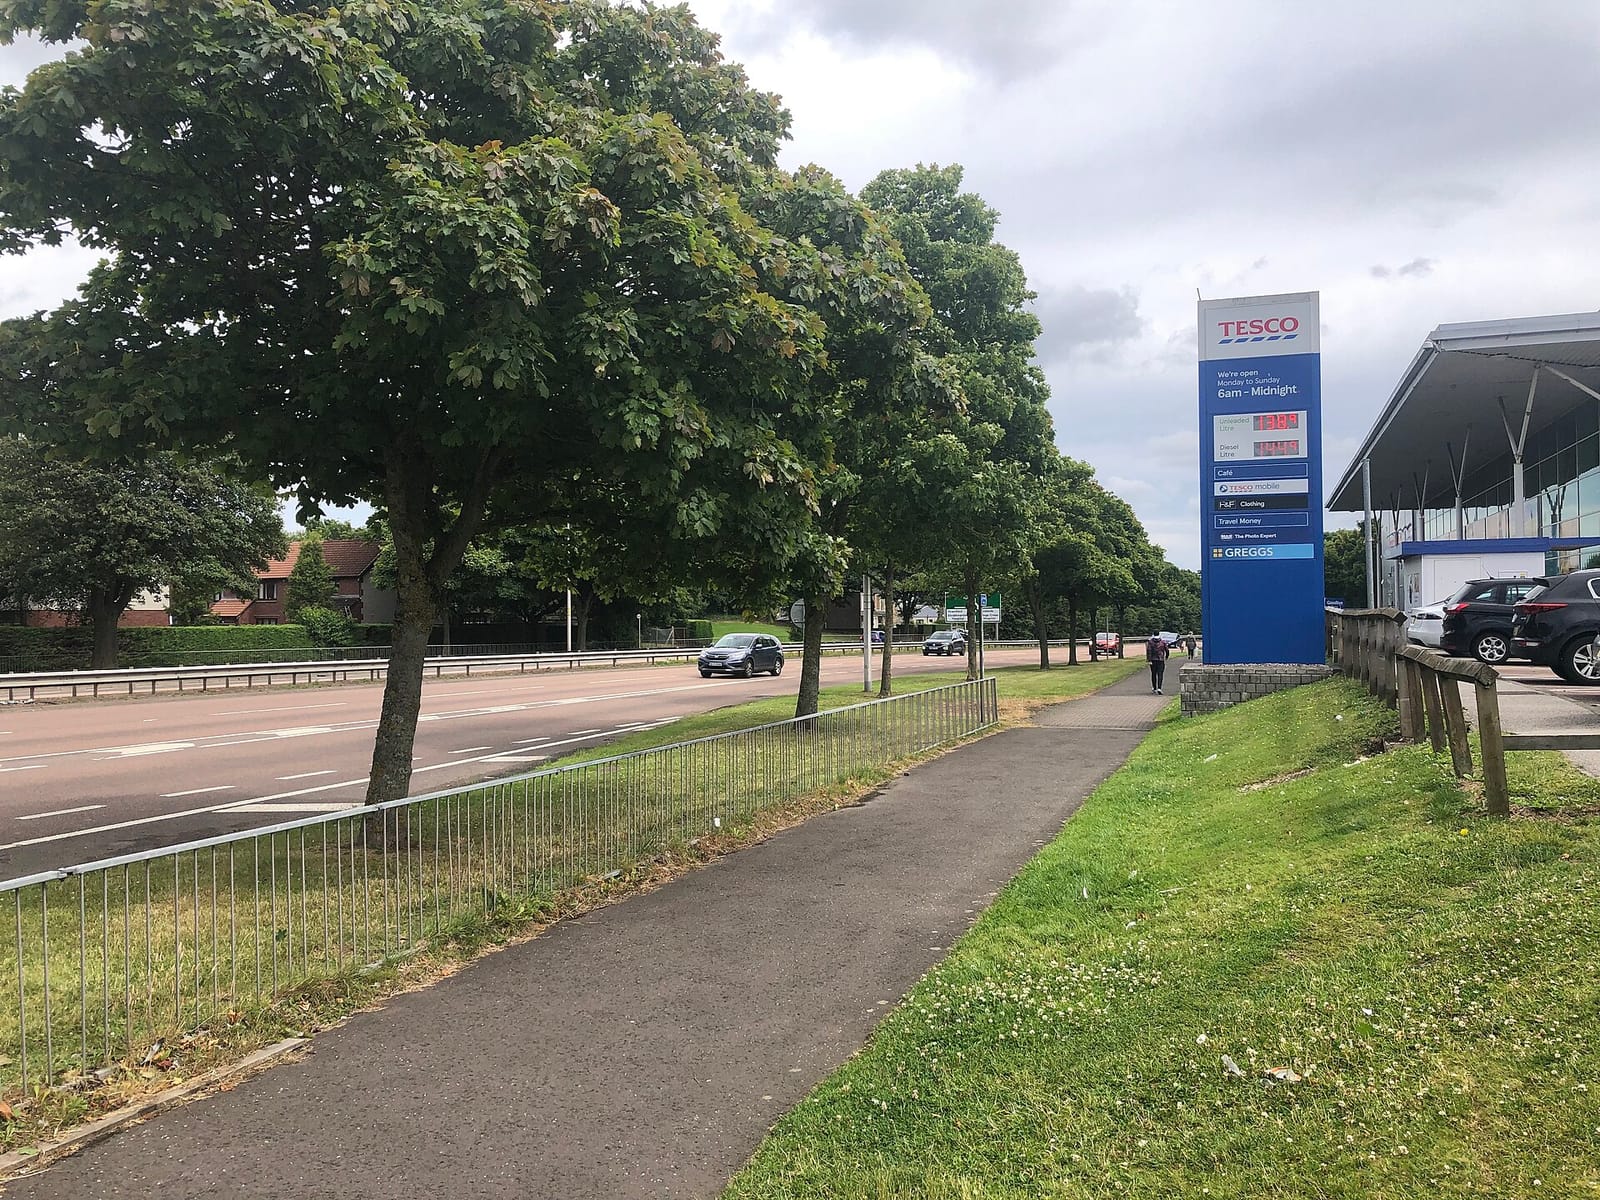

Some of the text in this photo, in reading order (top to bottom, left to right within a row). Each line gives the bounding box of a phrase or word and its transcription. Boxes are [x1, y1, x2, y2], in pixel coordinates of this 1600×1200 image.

[1218, 317, 1299, 337] TESCO
[1217, 370, 1259, 378] We're open
[1217, 376, 1280, 387] Monday to Sunday
[1217, 388, 1242, 399] 6am
[1251, 384, 1297, 398] Midnight
[1219, 416, 1250, 425] Unleaded
[1219, 425, 1235, 433] Litre
[1219, 443, 1239, 451] Diesel
[1219, 451, 1235, 459] Litre
[1240, 500, 1265, 508] Clothing
[1239, 517, 1262, 525] Money
[1225, 548, 1274, 557] GREGGS
